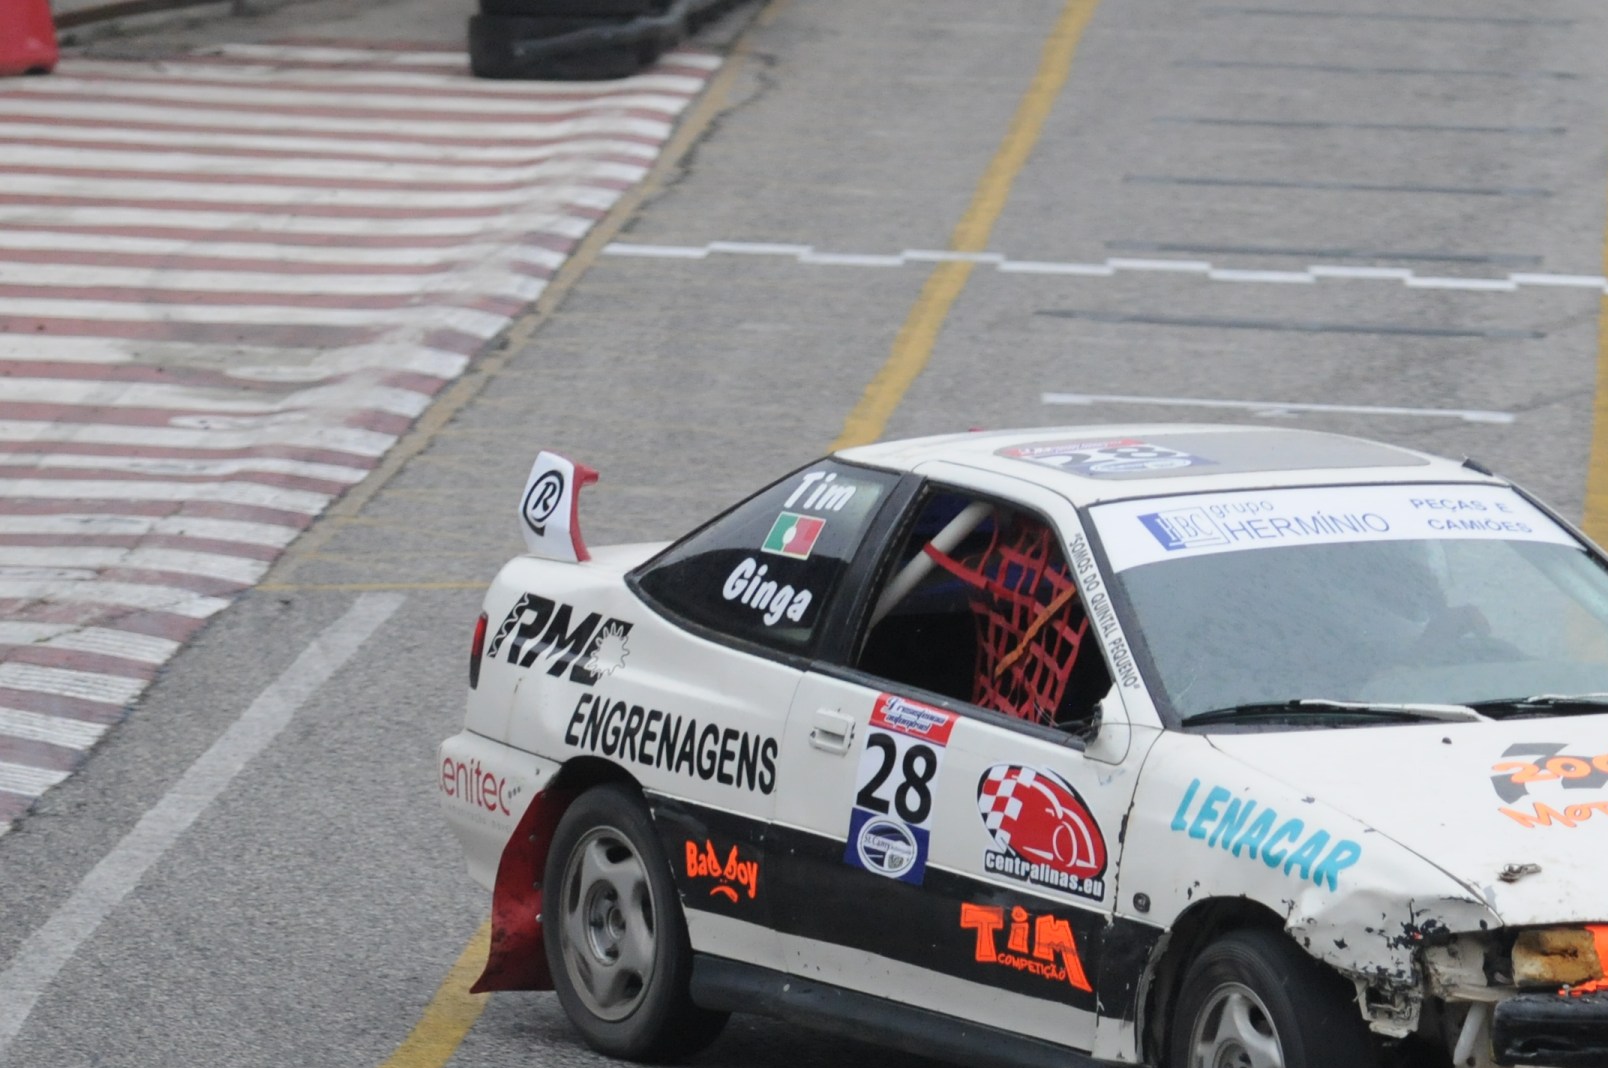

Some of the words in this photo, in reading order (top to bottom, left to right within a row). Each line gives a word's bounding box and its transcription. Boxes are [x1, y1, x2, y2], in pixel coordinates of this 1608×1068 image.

[784, 471, 856, 511] Tim
[1209, 500, 1275, 518] grupo
[1410, 499, 1487, 512] PEÇAS
[1223, 511, 1390, 541] HERMÍNIO
[722, 557, 813, 627] Ginga
[1083, 573, 1100, 591] DO
[1090, 592, 1119, 639] QUINTAL
[564, 693, 779, 796] ENGRENAGENS
[856, 732, 938, 825] 28
[1170, 778, 1362, 893] LENACAR
[985, 851, 1103, 899] centralinas.eu
[997, 952, 1067, 981] COMPETIÇÃO
